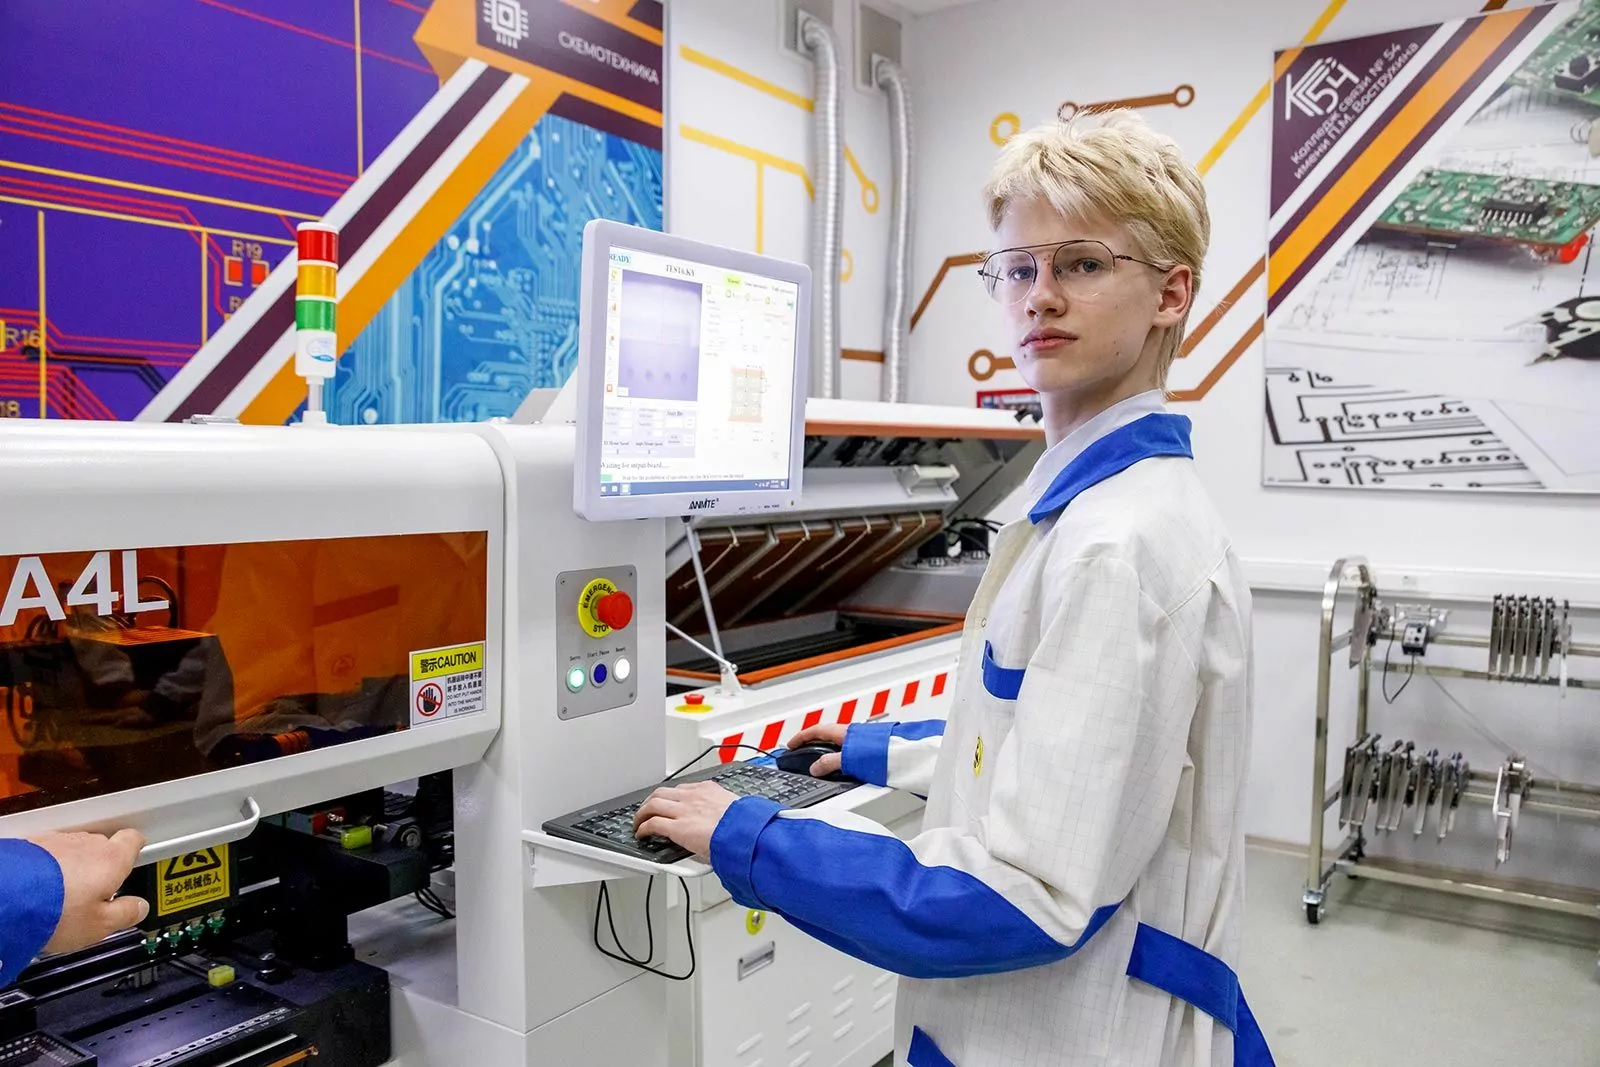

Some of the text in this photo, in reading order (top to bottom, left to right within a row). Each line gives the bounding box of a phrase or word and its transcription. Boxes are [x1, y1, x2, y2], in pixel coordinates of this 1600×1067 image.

[558, 31, 660, 85] СХЕМОТЕХНИКА
[1290, 111, 1343, 165] Колледж
[1339, 75, 1372, 113] связи
[1383, 43, 1402, 62] 54
[1294, 42, 1420, 180] имени П.М. Вострухина
[232, 240, 262, 261] R19
[6, 327, 42, 348] R16
[0, 549, 170, 627] A4L
[165, 872, 221, 897] 当心机械伤人
